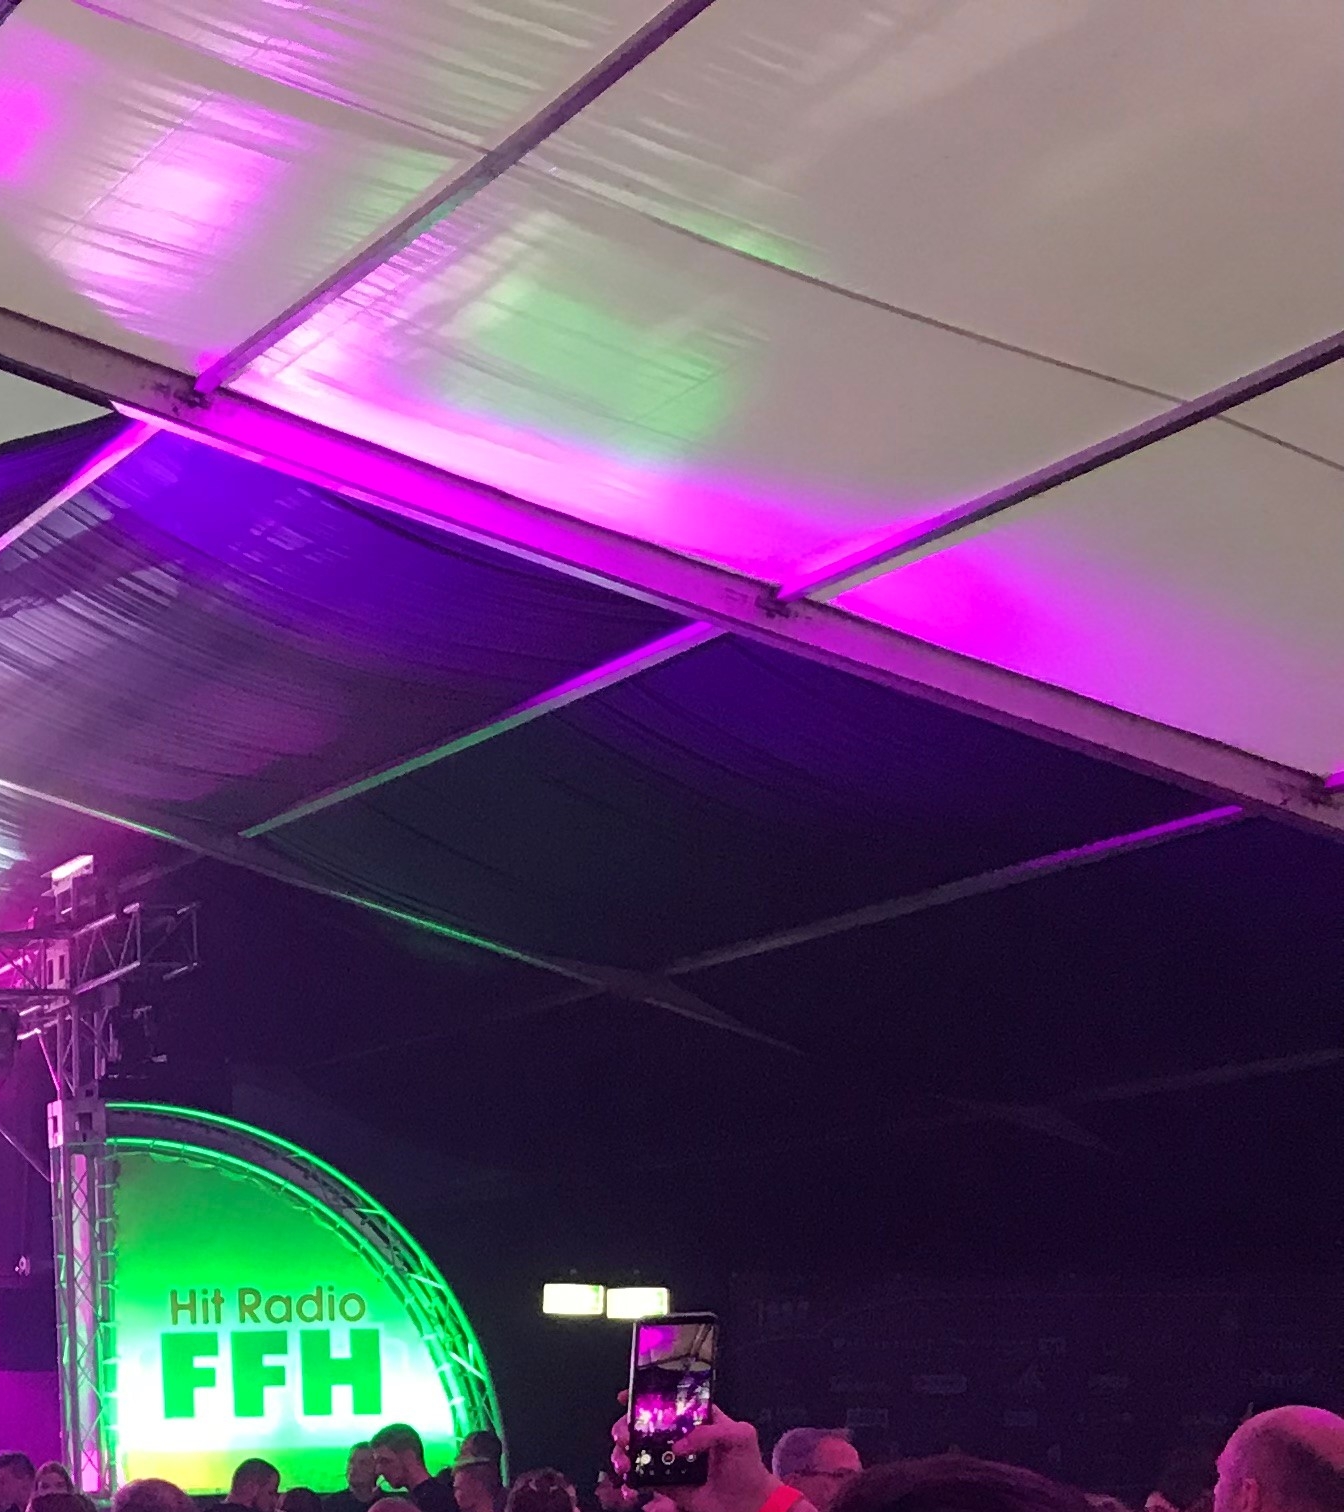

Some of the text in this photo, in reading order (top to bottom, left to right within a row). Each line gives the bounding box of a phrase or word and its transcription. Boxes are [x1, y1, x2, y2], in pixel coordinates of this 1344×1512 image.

[169, 1285, 366, 1325] Hit Radio
[161, 1329, 382, 1419] FFH
